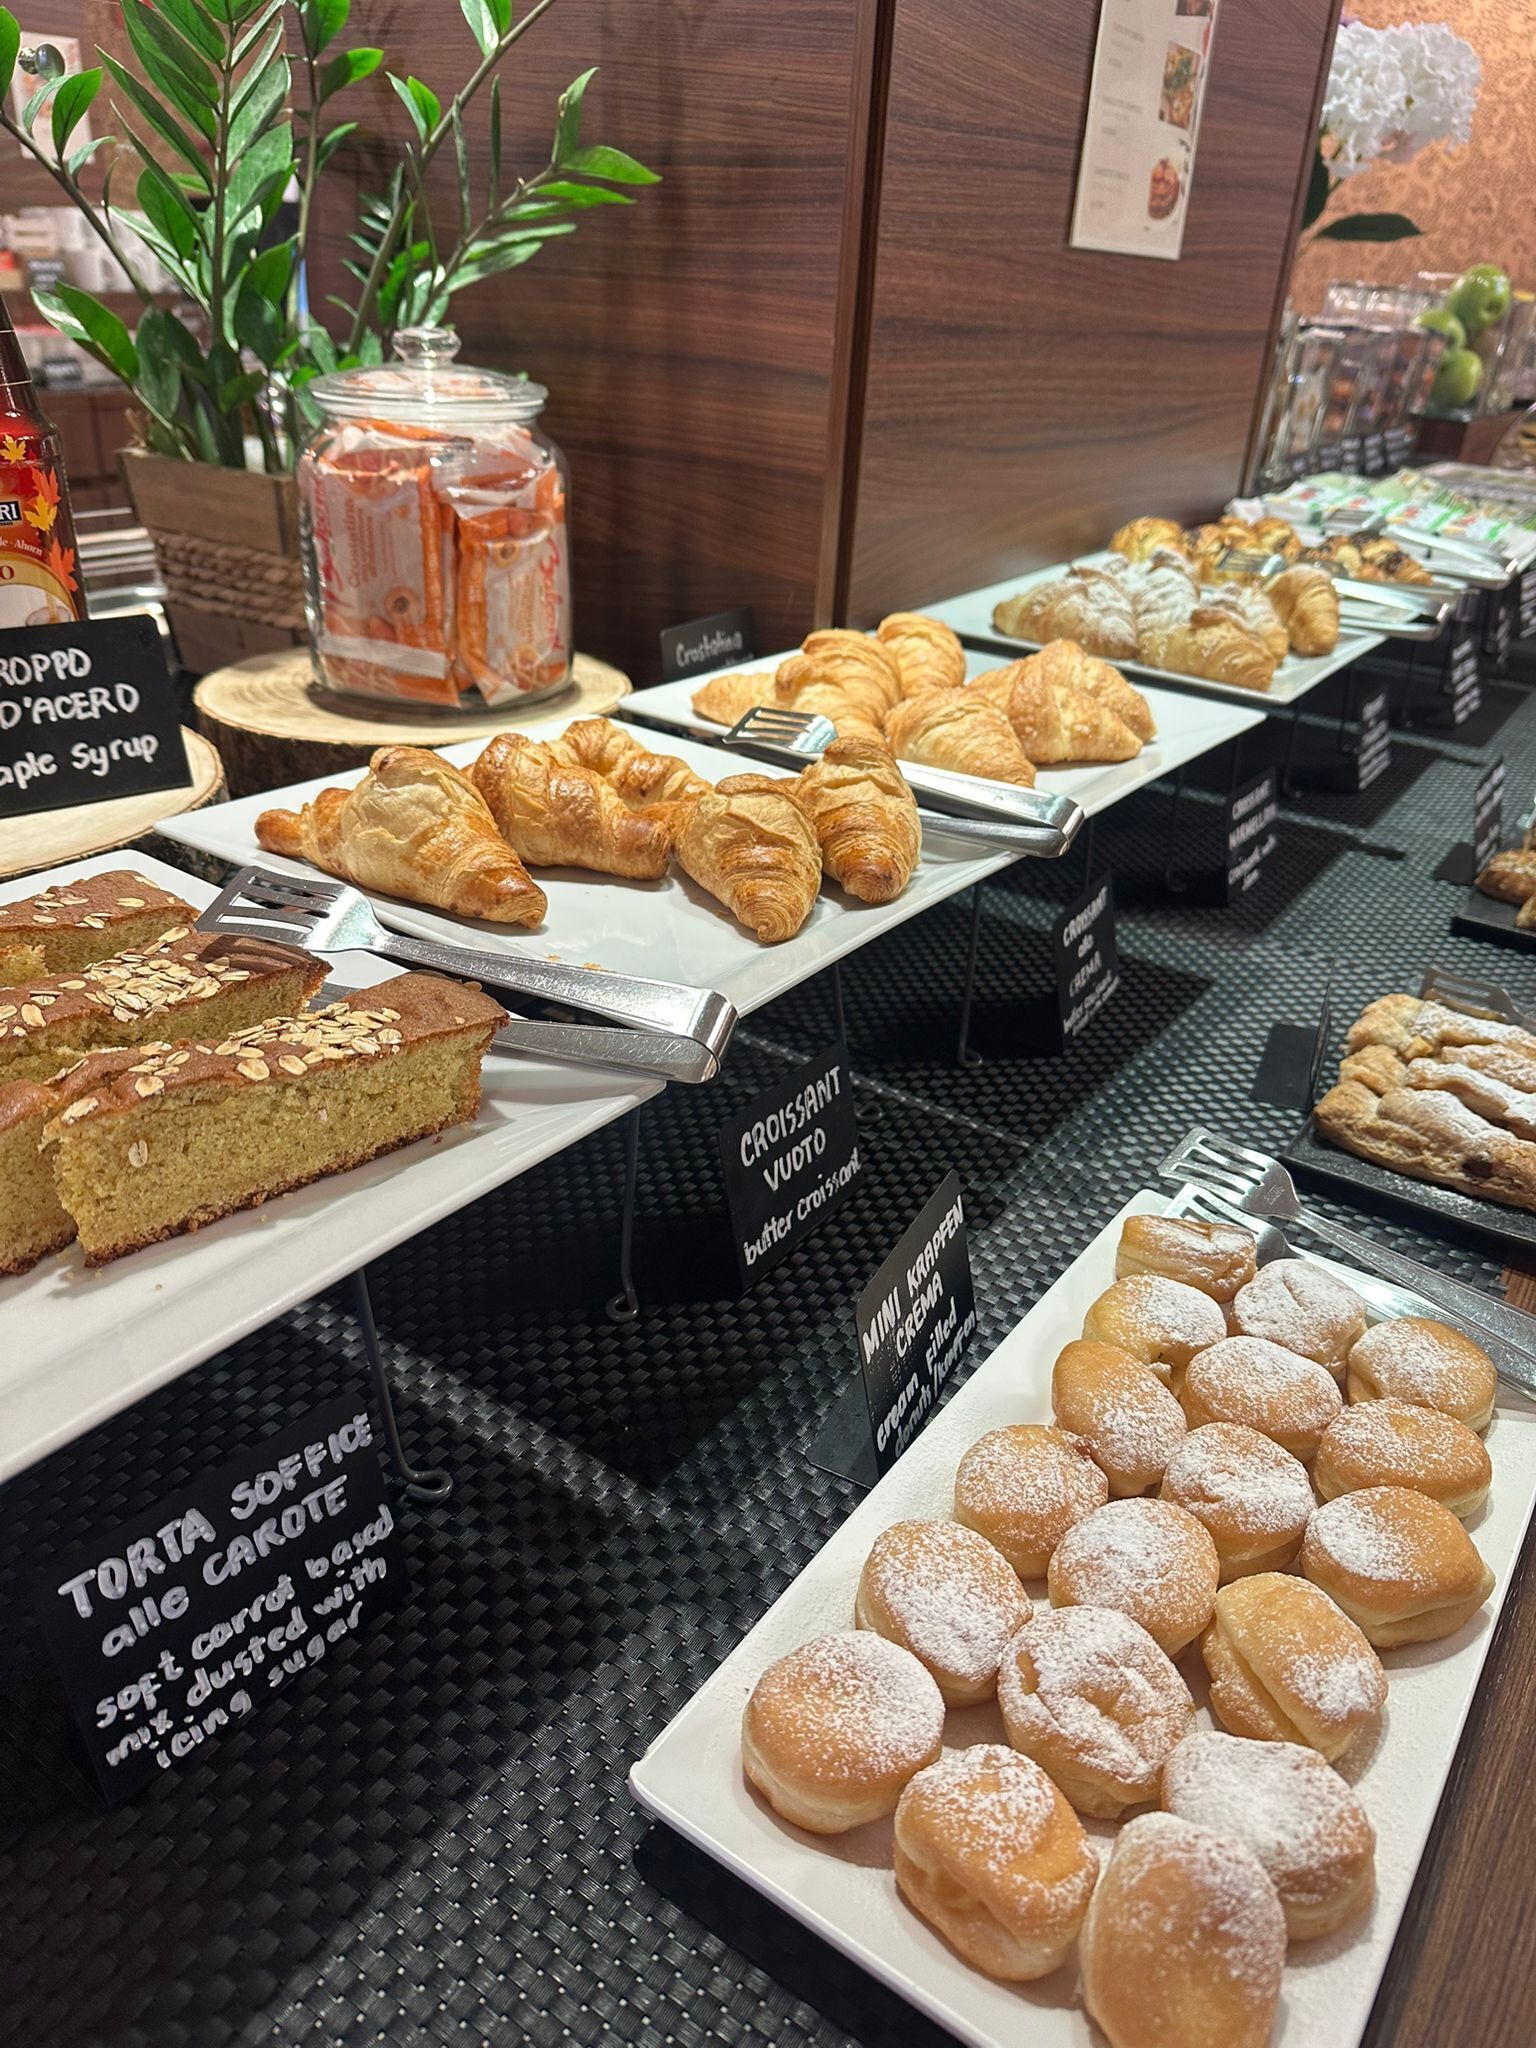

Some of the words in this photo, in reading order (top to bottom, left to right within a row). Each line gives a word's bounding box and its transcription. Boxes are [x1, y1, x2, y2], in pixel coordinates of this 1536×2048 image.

[15, 540, 42, 556] Ahorn
[0, 683, 140, 729] D'ACERO
[740, 1065, 840, 1167] CROISSANT
[763, 1127, 826, 1192] VUOTO
[743, 1209, 794, 1266] butter
[796, 1147, 862, 1221] croissant
[862, 1286, 901, 1365] MINI
[906, 1194, 964, 1298] KRAPFEN
[896, 1270, 944, 1358] CREMA
[876, 1371, 920, 1453] cream
[57, 1507, 217, 1618] TORTA
[230, 1412, 374, 1520] SOFFICE
[101, 1585, 190, 1658] alle
[202, 1474, 348, 1586] CAROTE
[96, 1649, 185, 1728] soft
[190, 1573, 296, 1661] carrot
[304, 1503, 395, 1580] based
[105, 1708, 174, 1768] mix
[186, 1605, 309, 1707] dusted
[312, 1556, 388, 1616] with
[149, 1688, 253, 1769] icing
[267, 1600, 363, 1688] sugar
